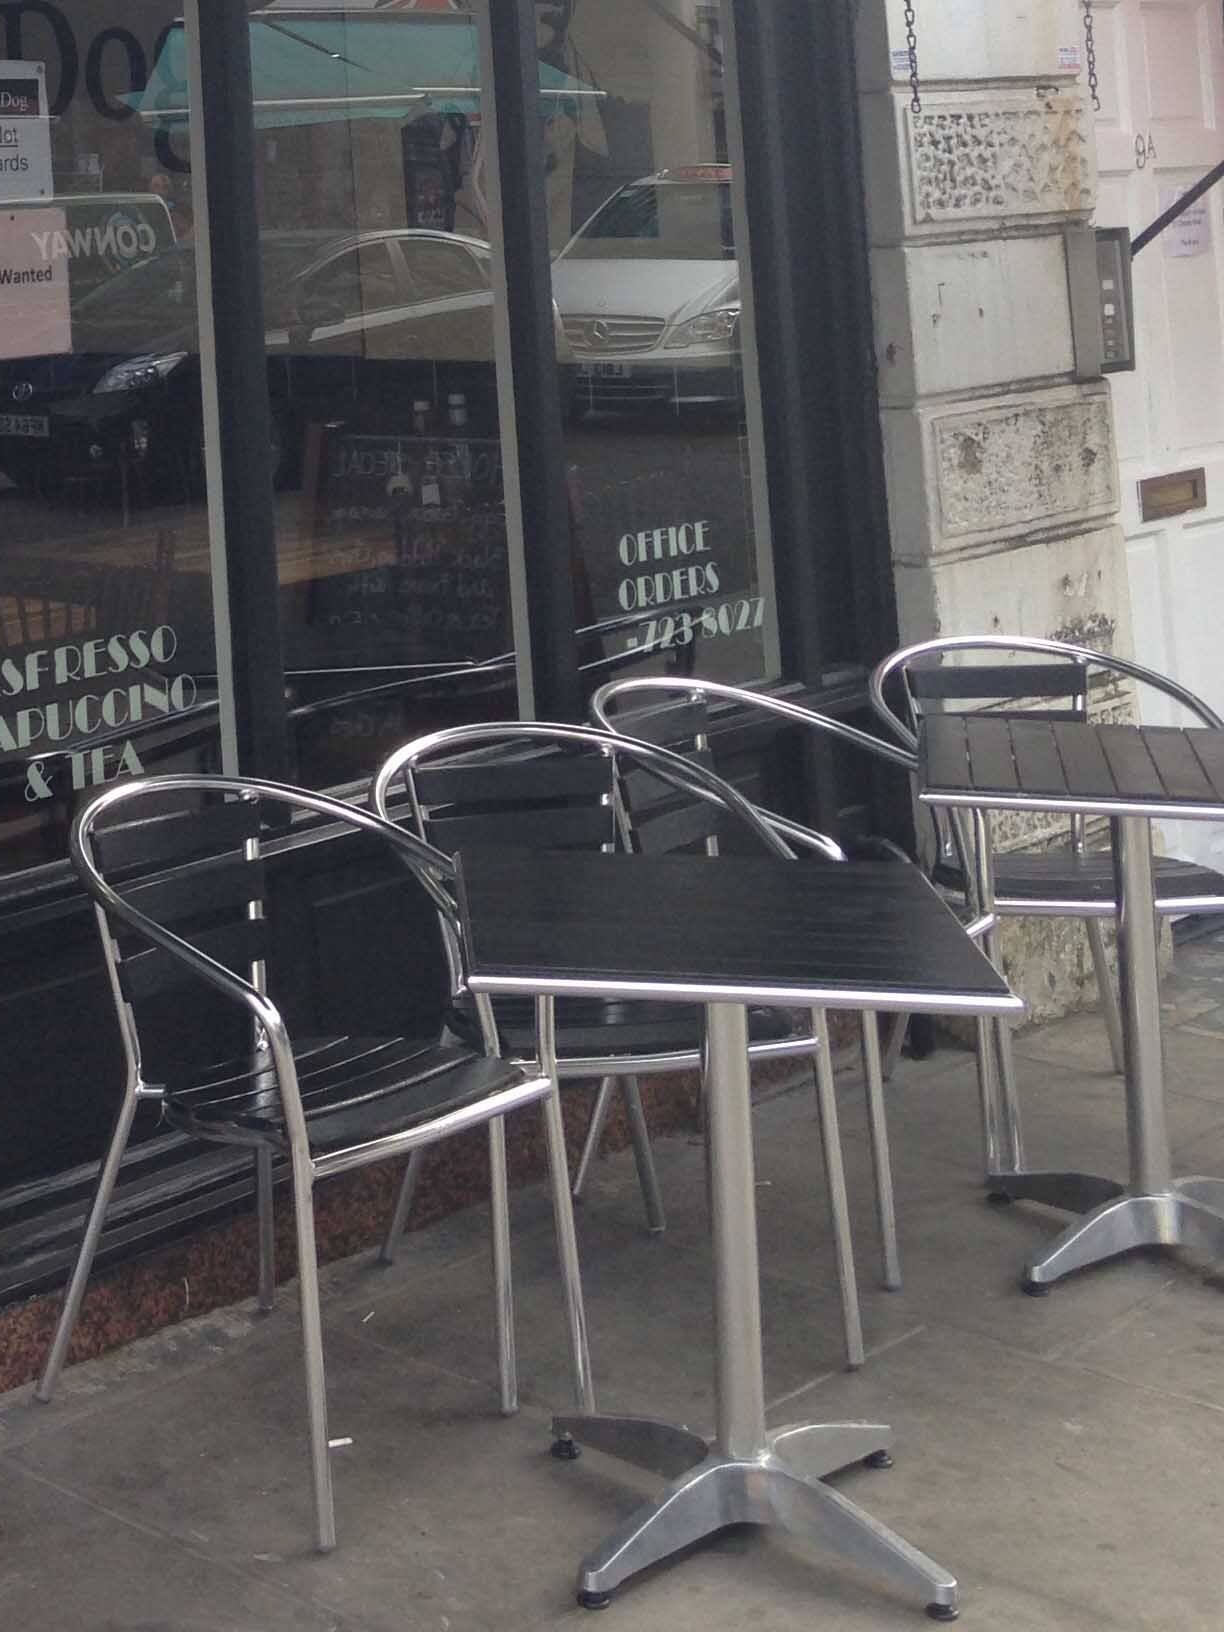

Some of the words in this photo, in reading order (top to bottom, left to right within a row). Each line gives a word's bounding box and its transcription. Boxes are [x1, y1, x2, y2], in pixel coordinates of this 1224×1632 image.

[0, 90, 28, 112] Dog
[619, 520, 712, 567] OFFICE
[618, 562, 720, 611] ORDERS
[701, 597, 767, 639] 8027
[25, 760, 54, 802] &
[65, 739, 145, 790] TEA
